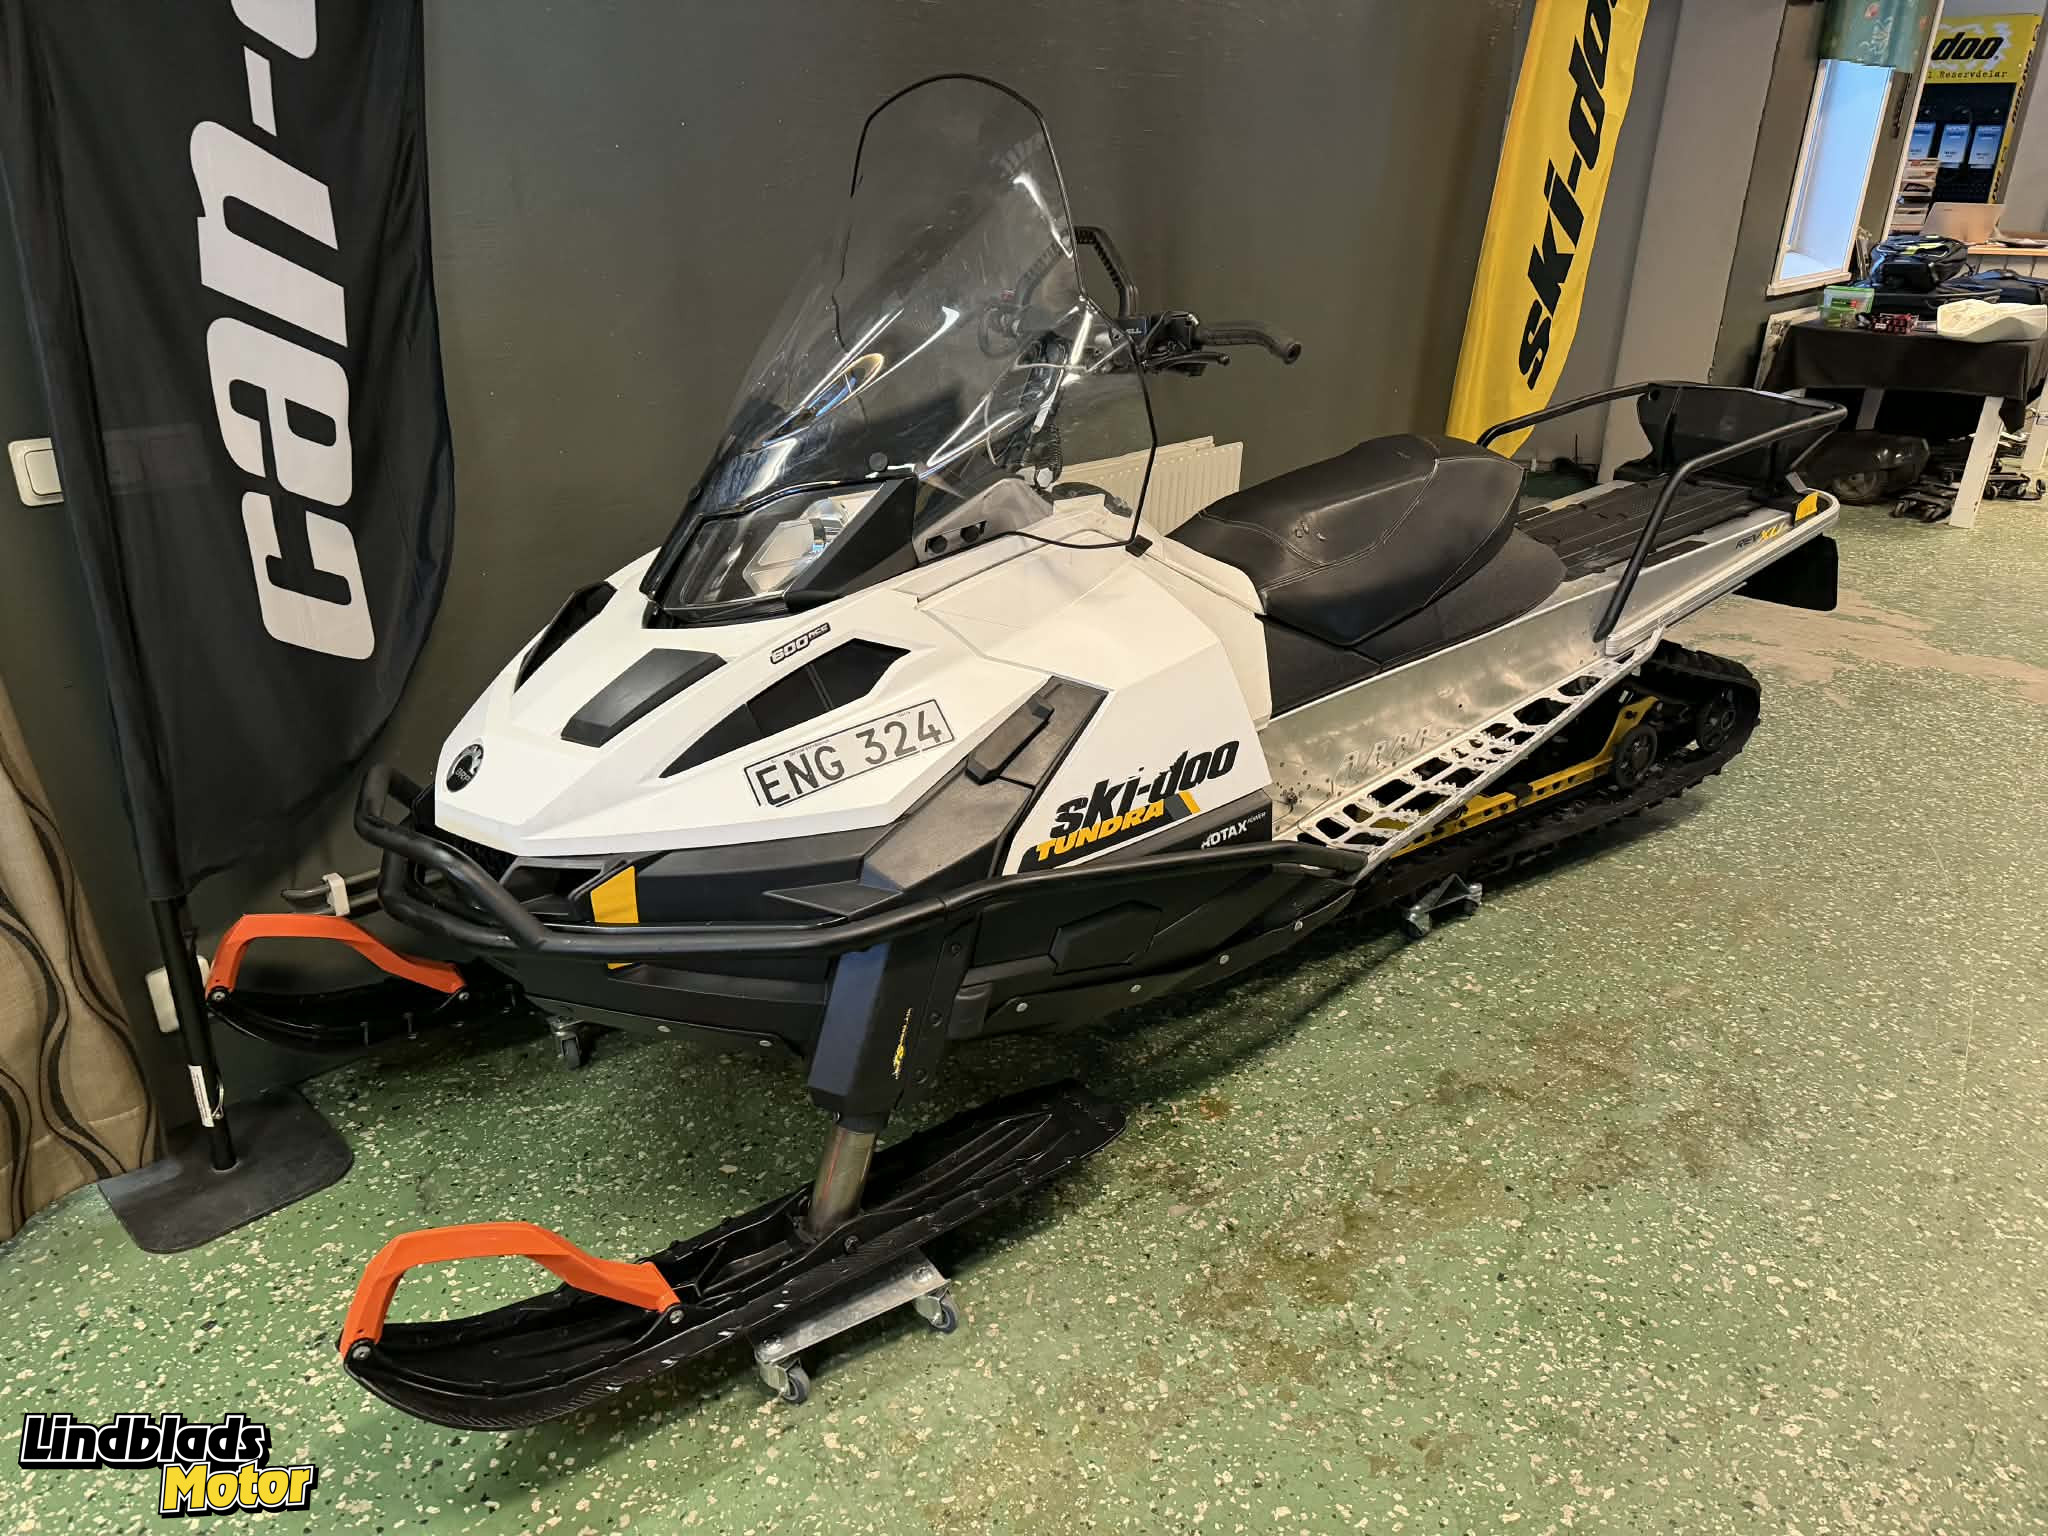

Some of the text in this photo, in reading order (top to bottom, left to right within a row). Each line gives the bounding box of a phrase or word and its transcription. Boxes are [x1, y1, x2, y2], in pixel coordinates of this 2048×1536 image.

[1518, 0, 1617, 391] ski-do
[771, 633, 809, 663] 600
[755, 710, 943, 806] ENG 324
[1049, 740, 1240, 839] ski-doo
[1035, 800, 1165, 862] TUNDRA
